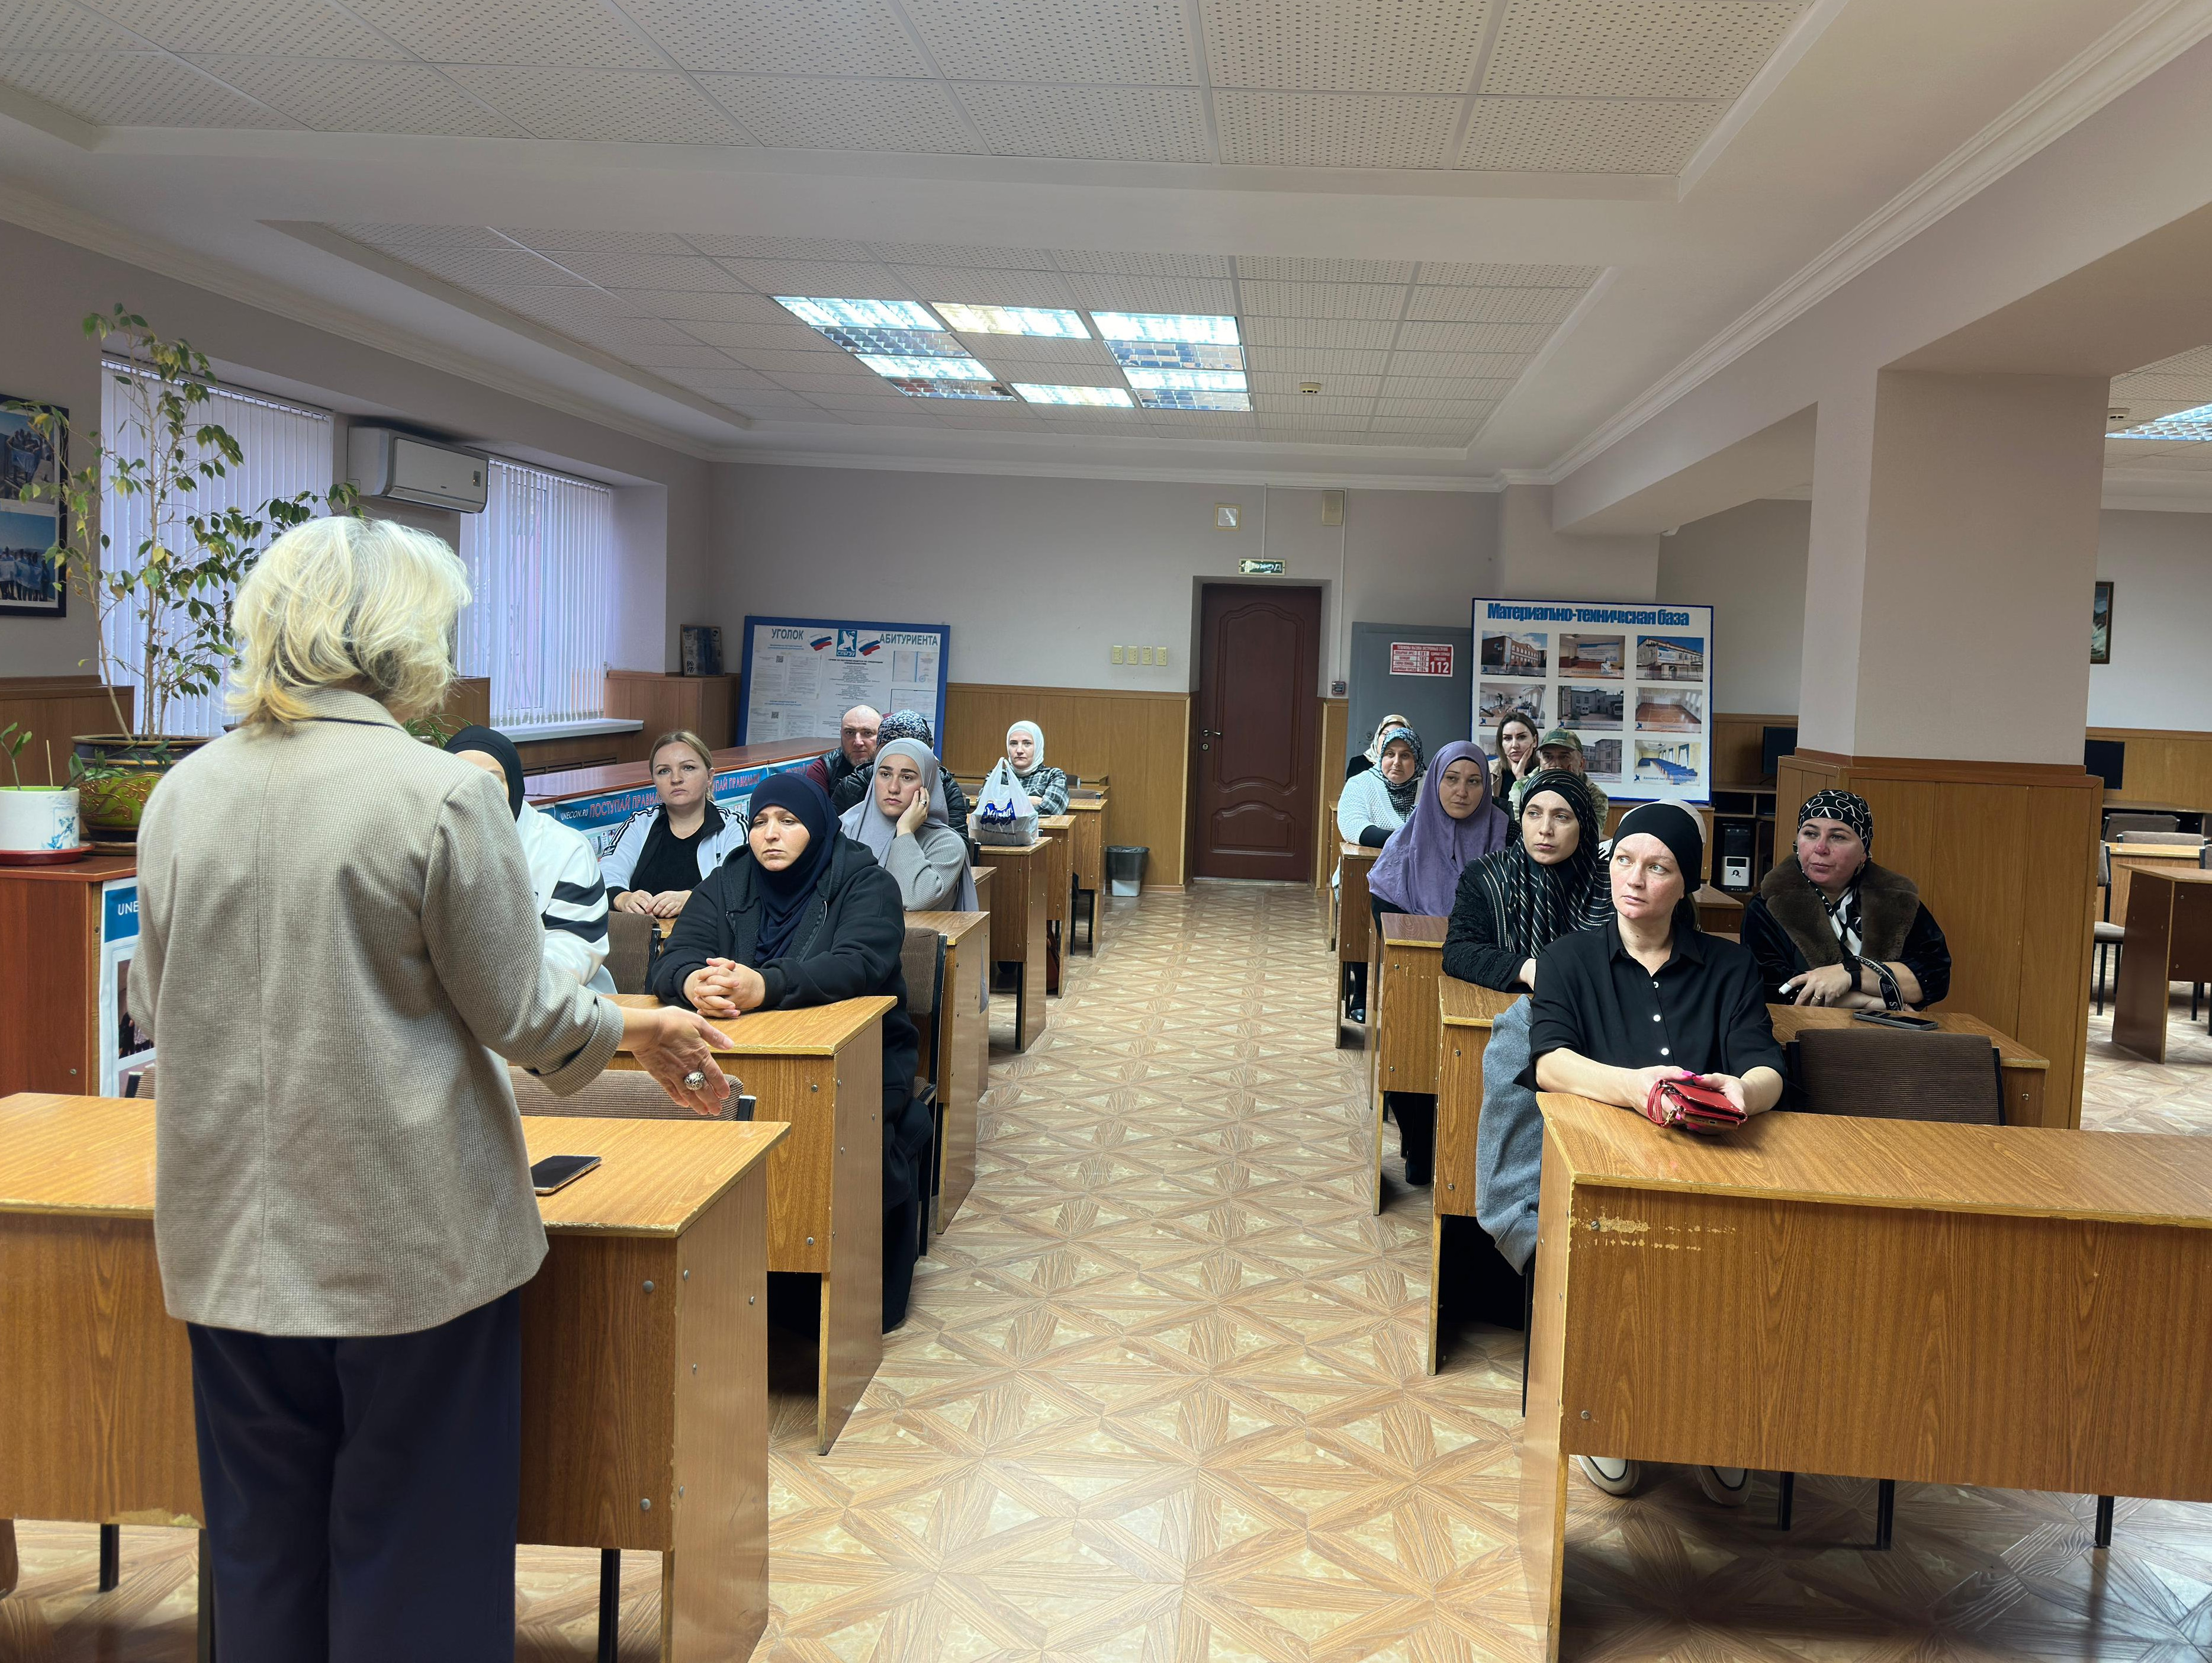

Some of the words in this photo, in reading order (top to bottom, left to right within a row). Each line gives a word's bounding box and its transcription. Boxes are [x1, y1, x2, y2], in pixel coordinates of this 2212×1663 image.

[1657, 609, 1689, 626] база
[771, 628, 803, 640] УГОЛОК
[879, 634, 938, 646] АБИТУРИЕНТА
[1430, 661, 1449, 673] 112
[589, 794, 631, 818] ПОСТУПАЙ
[560, 808, 589, 820] UNECON.RU
[118, 901, 139, 915] UNE
